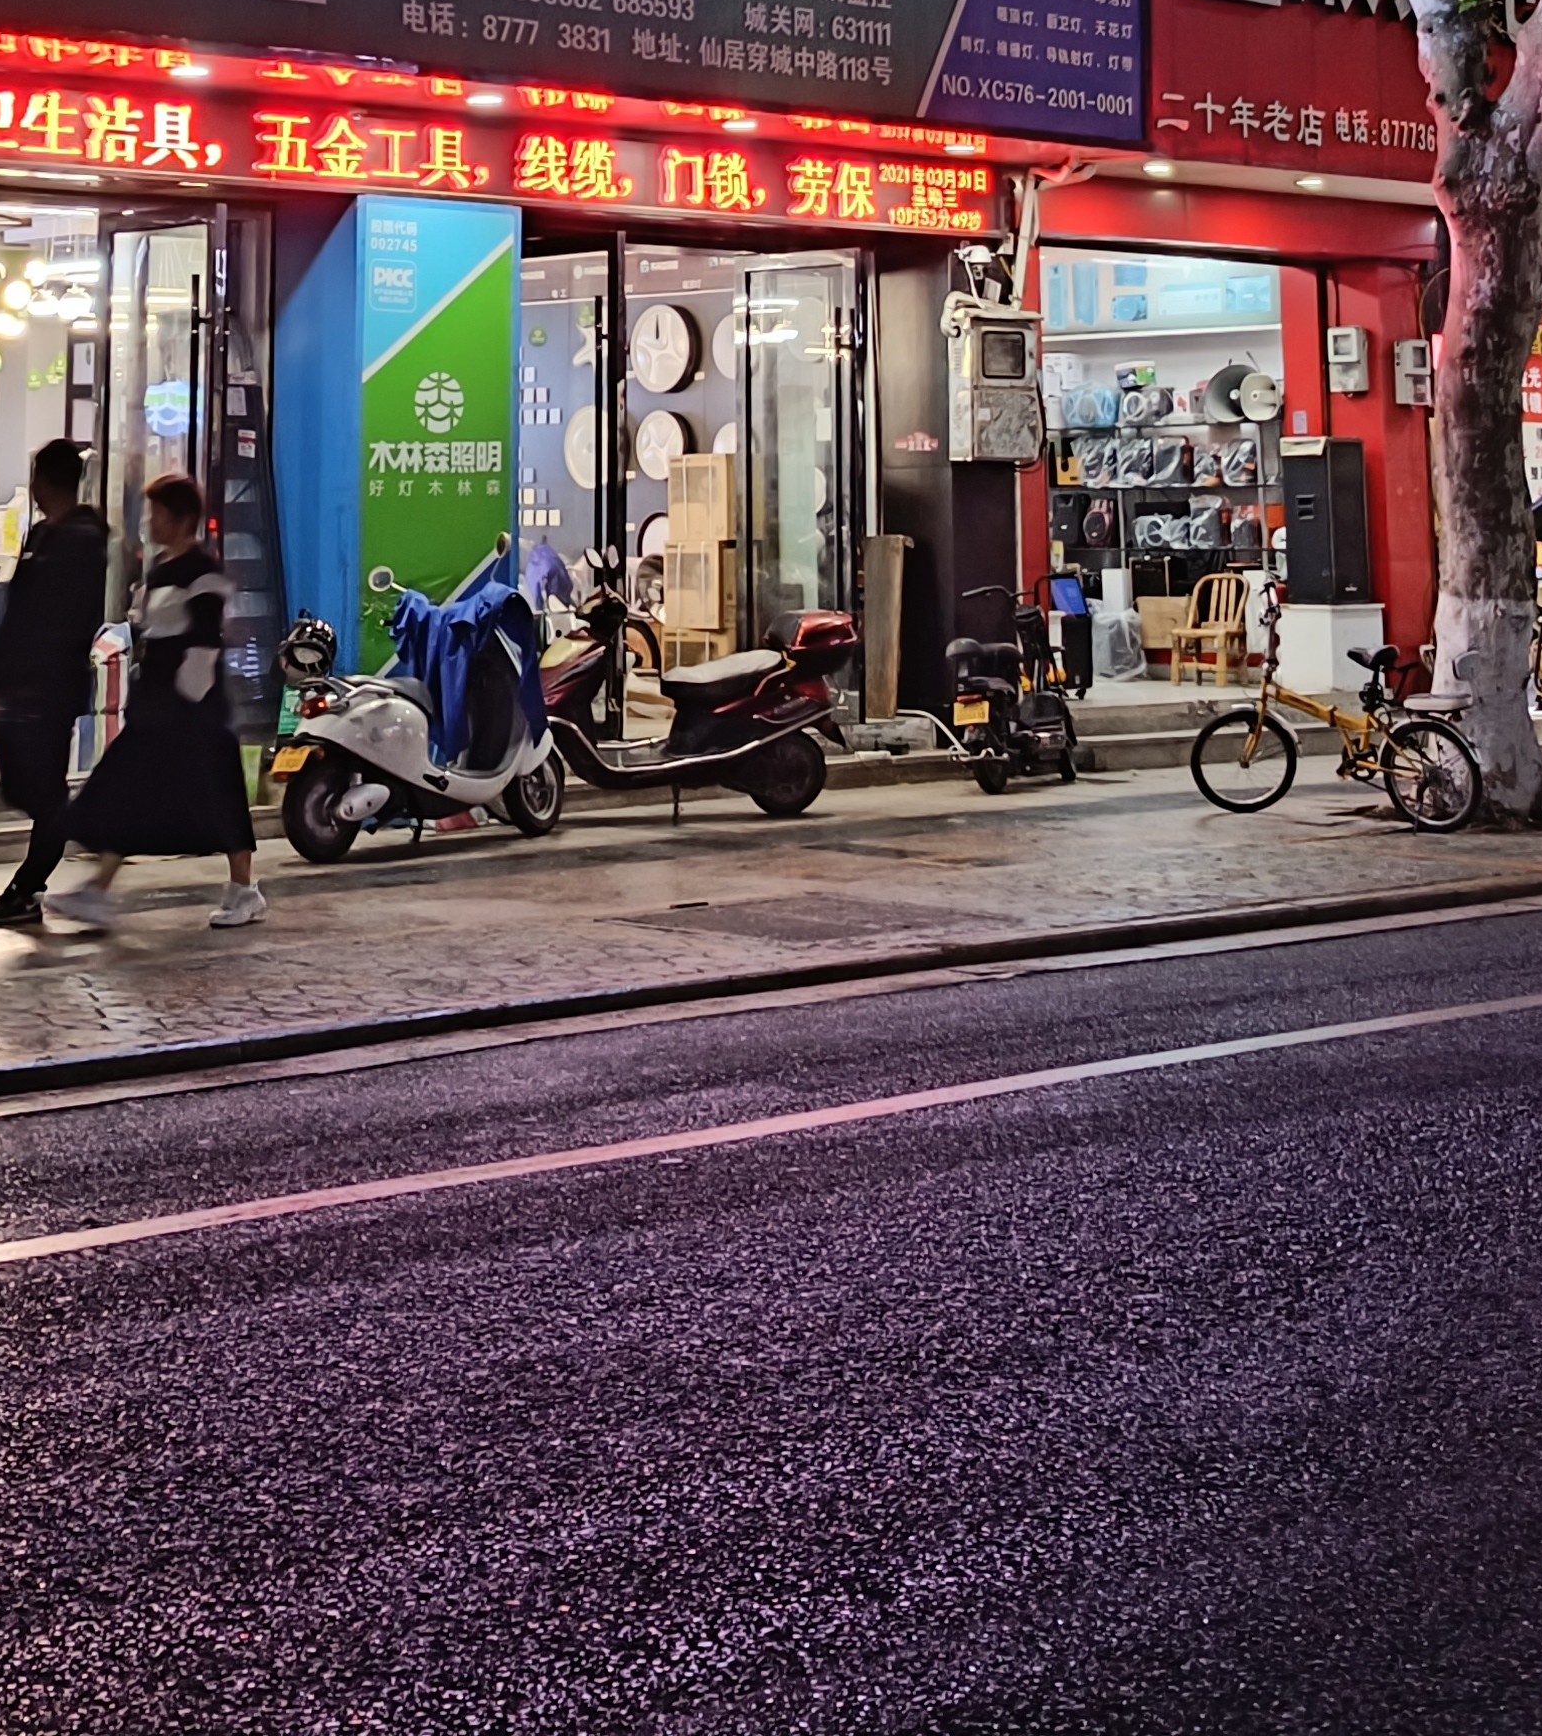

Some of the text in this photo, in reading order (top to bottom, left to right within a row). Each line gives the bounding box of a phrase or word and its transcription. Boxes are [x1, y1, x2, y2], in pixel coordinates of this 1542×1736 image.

[557, 22, 611, 53] 3831
[1157, 92, 1327, 147] 二十年老店
[878, 164, 987, 193] 2021年03月31日
[911, 184, 959, 209] 星期三
[370, 236, 418, 253] 002745
[373, 266, 414, 288] PICC
[368, 440, 503, 475] 木林森照明
[368, 479, 502, 498] 好灯木林森
